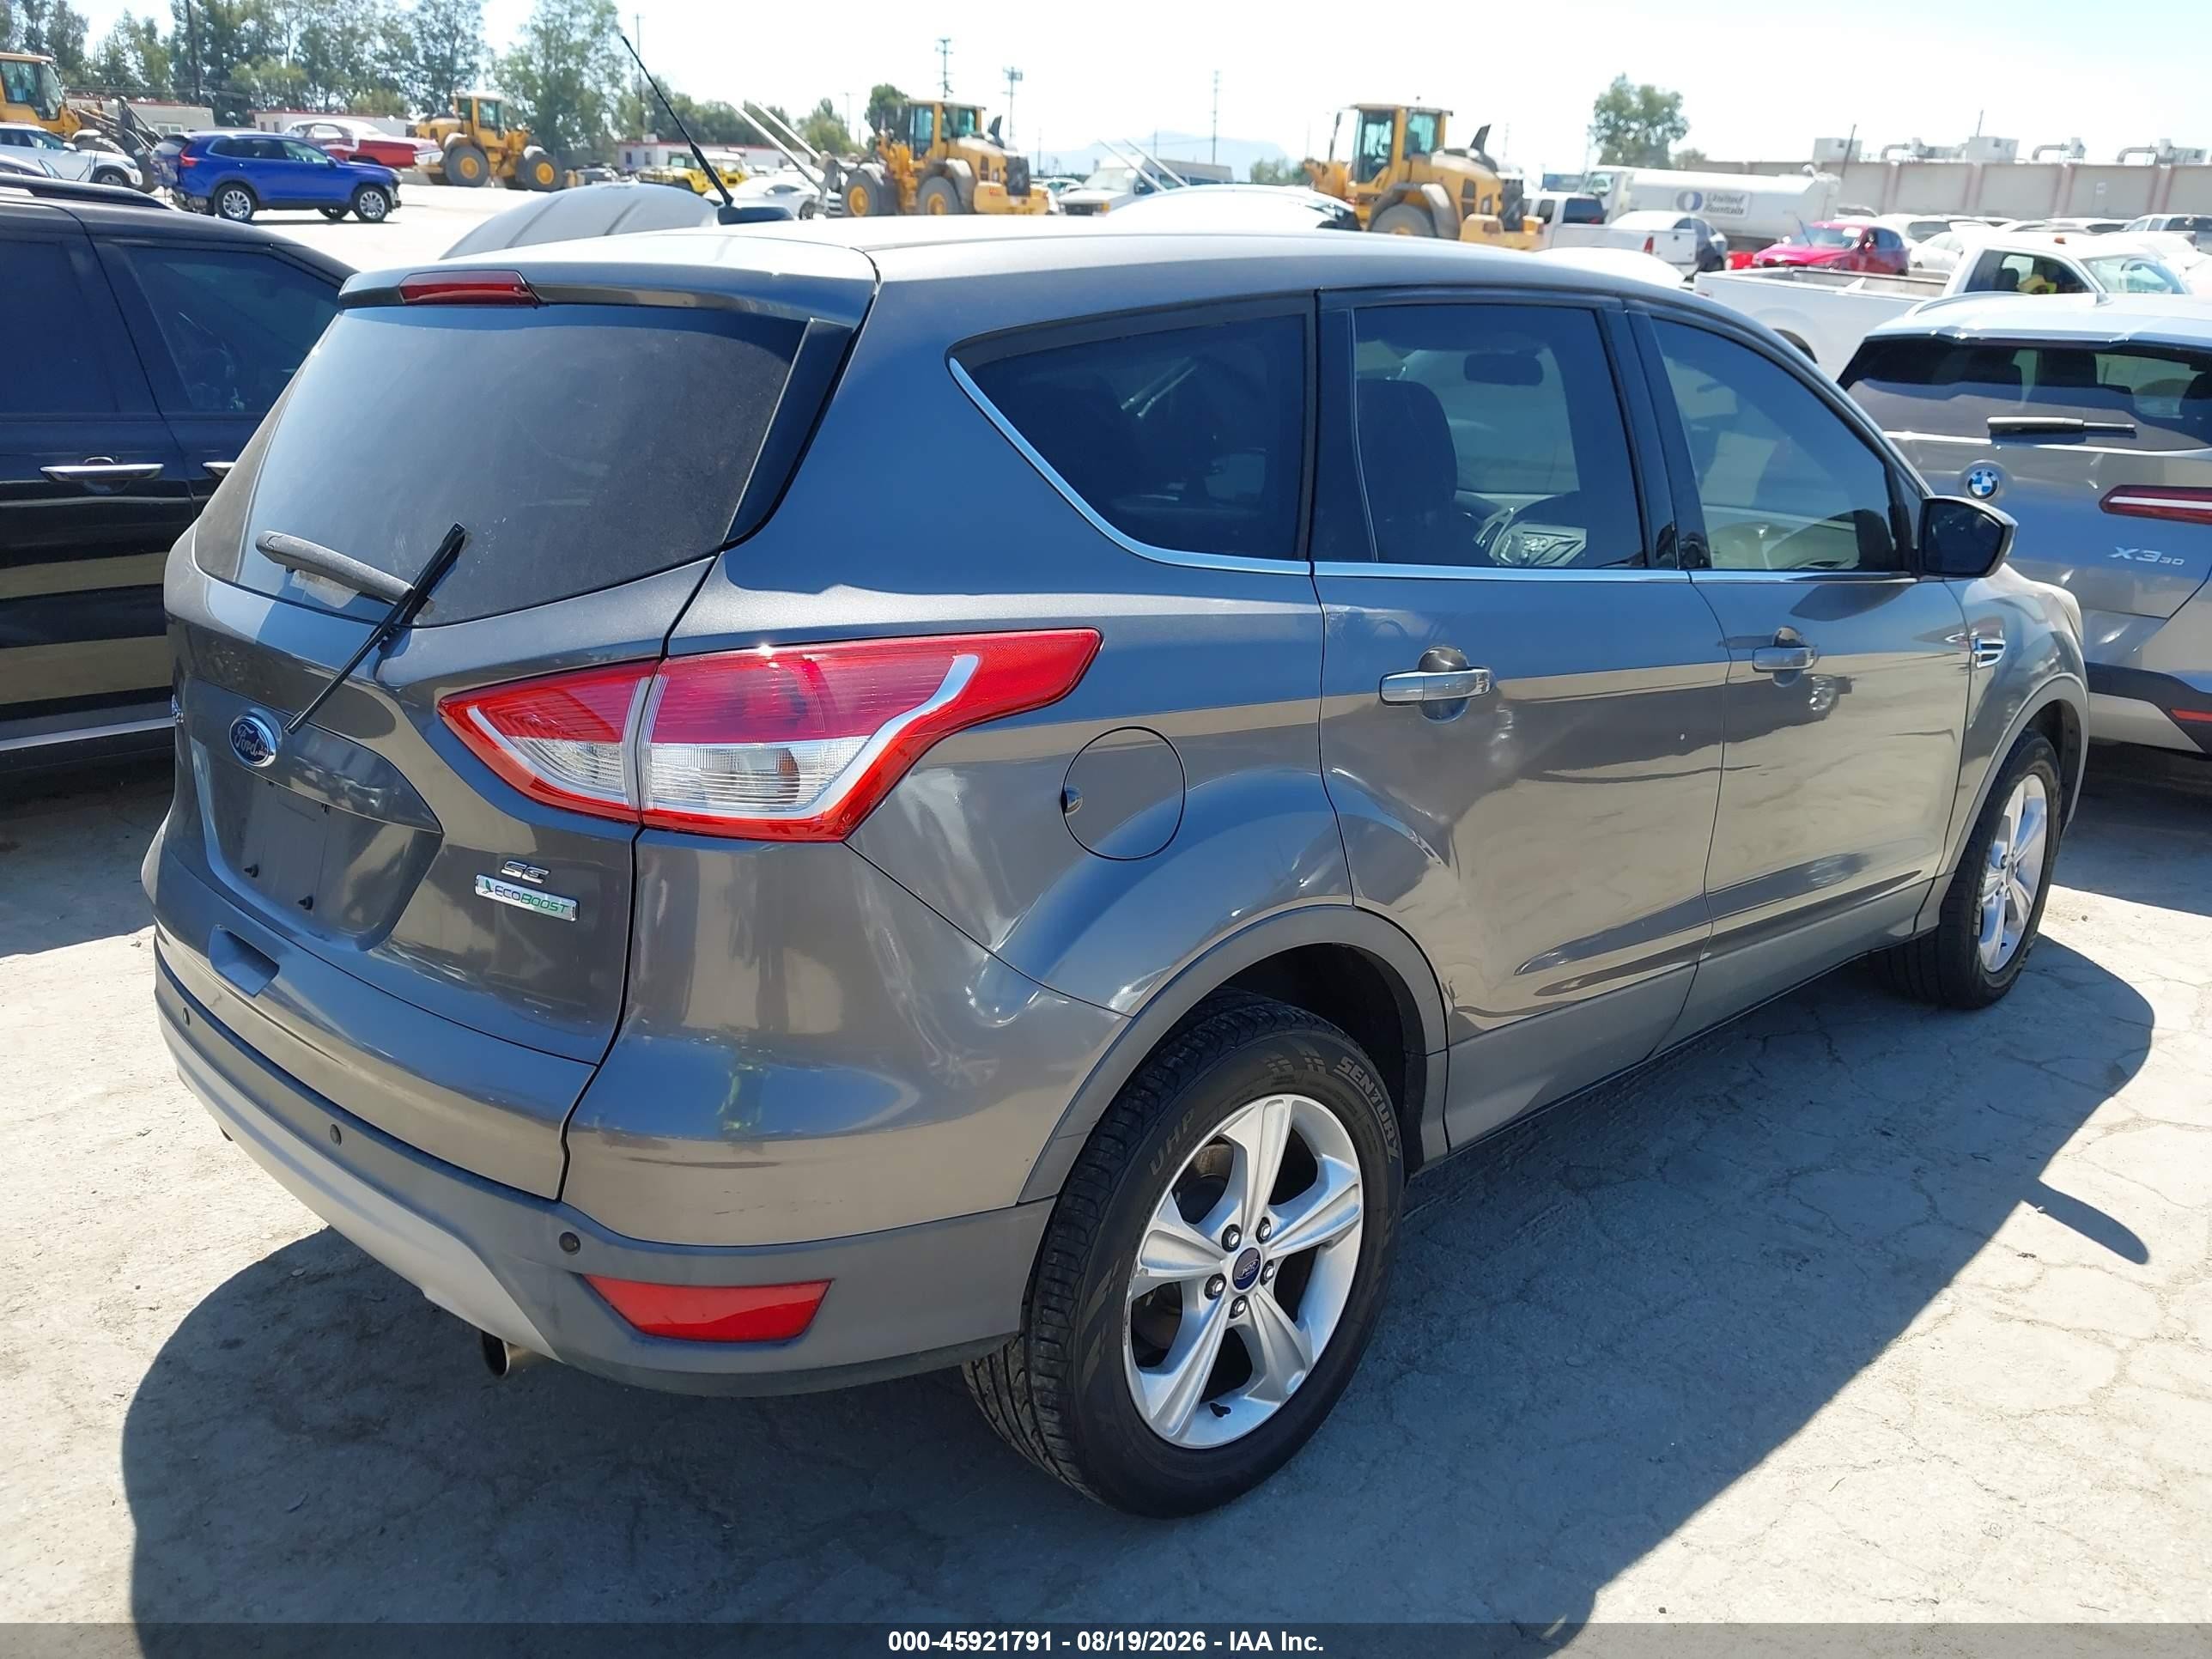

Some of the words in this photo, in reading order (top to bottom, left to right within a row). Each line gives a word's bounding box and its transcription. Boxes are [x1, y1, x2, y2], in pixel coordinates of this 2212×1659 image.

[1704, 204, 1745, 216] Rentals
[1706, 191, 1746, 204] United
[234, 723, 268, 757] Ford
[501, 860, 550, 884] SE
[494, 884, 569, 914] ECOBOOST
[1334, 1055, 1401, 1164] SENTURY
[1149, 1109, 1195, 1176] UHP
